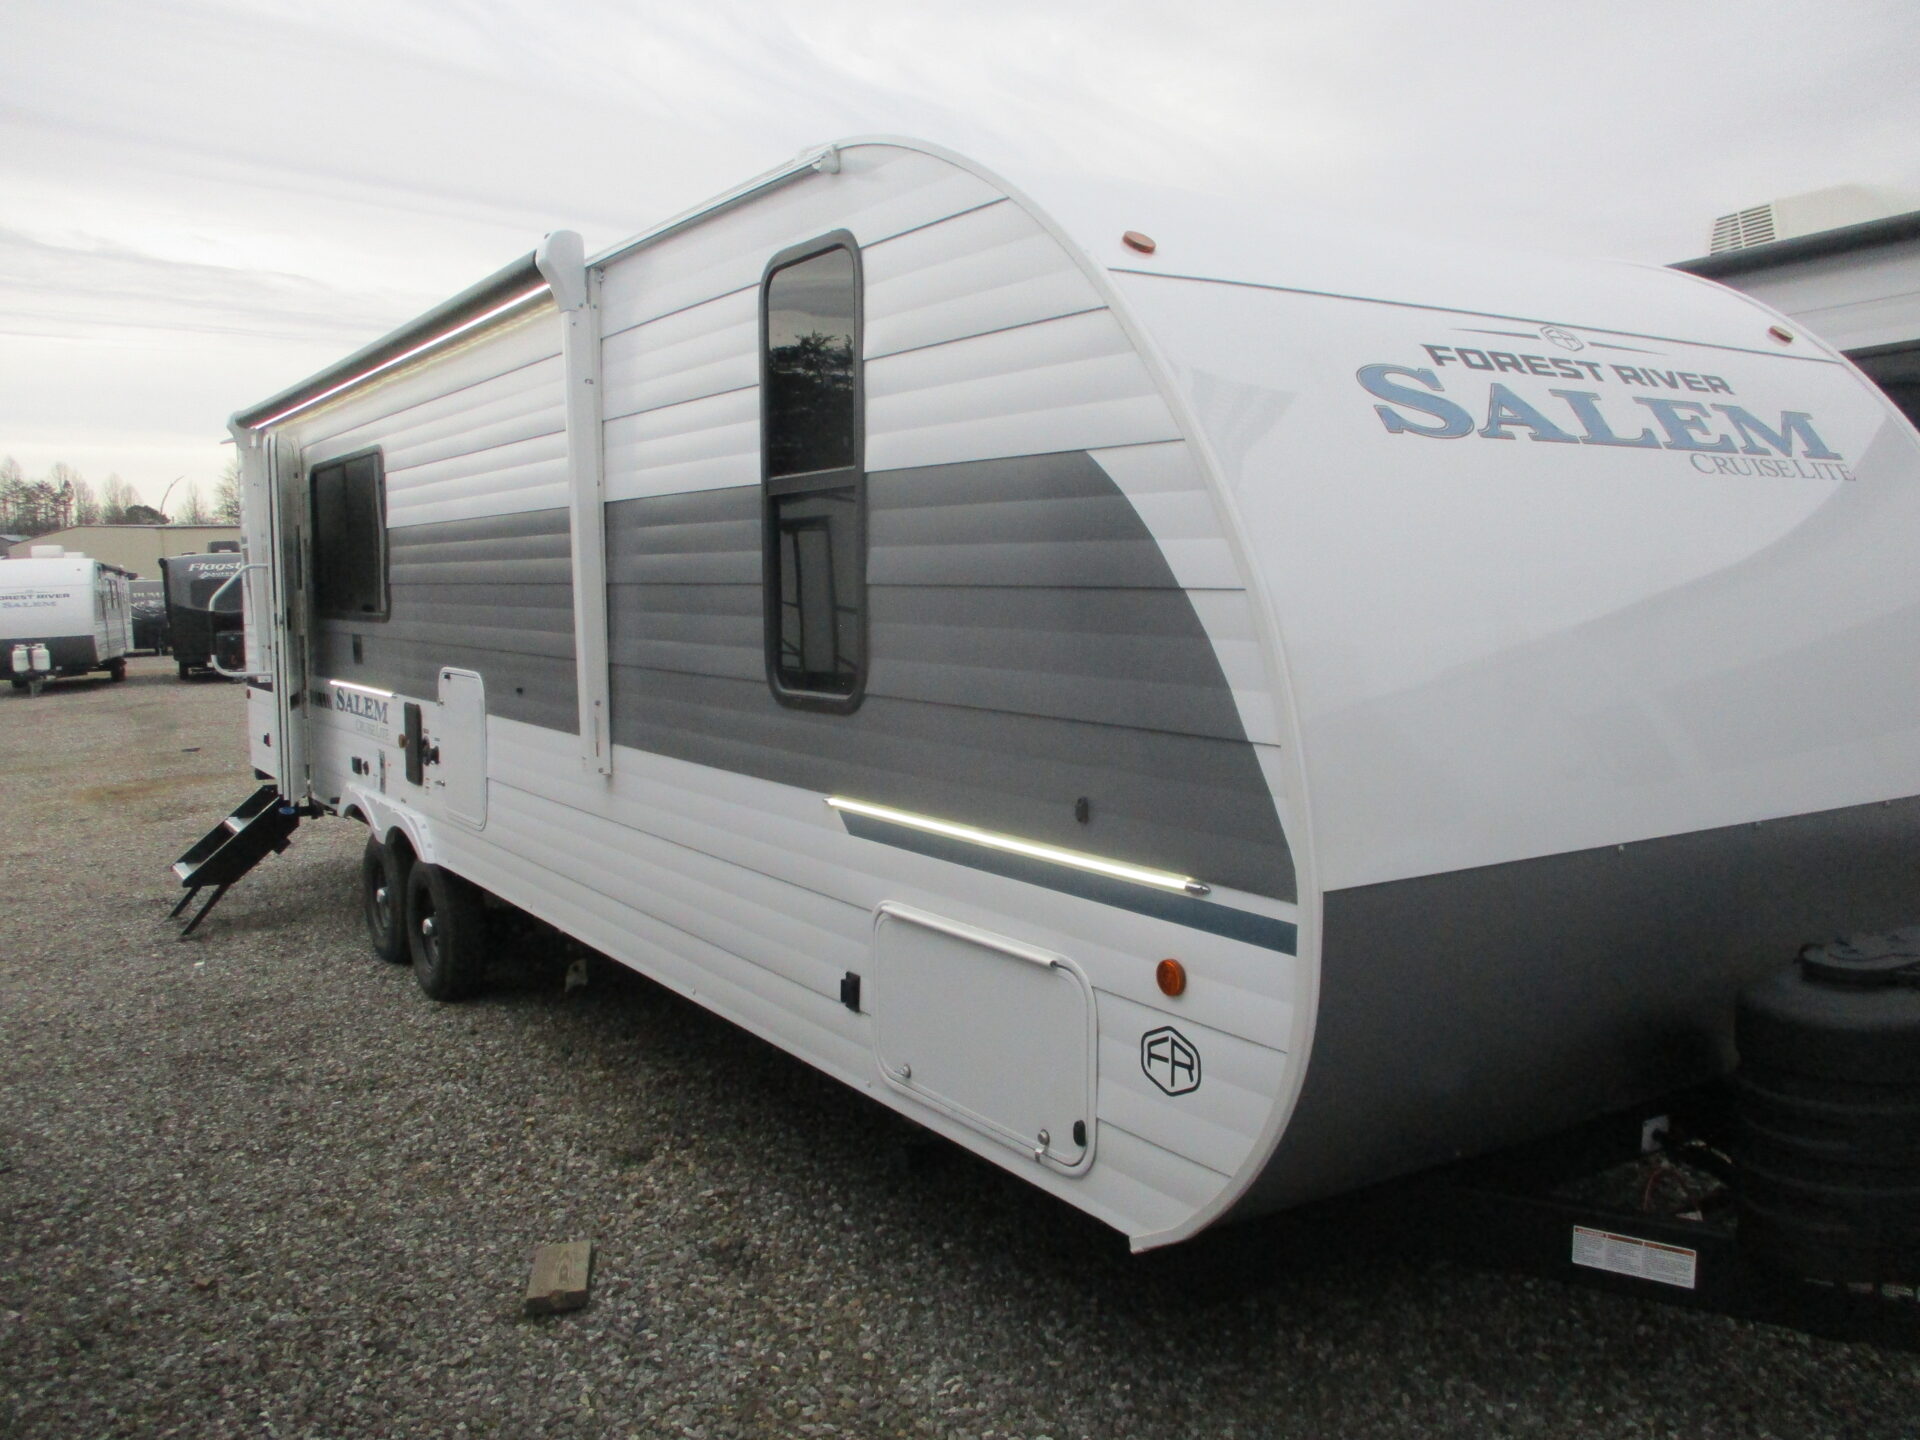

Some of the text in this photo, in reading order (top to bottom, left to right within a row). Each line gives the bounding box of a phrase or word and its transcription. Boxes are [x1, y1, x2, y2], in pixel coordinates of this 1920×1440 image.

[1421, 344, 1736, 395] FOREST RIVER
[1356, 362, 1844, 461] SALEM
[336, 686, 389, 724] SALEM
